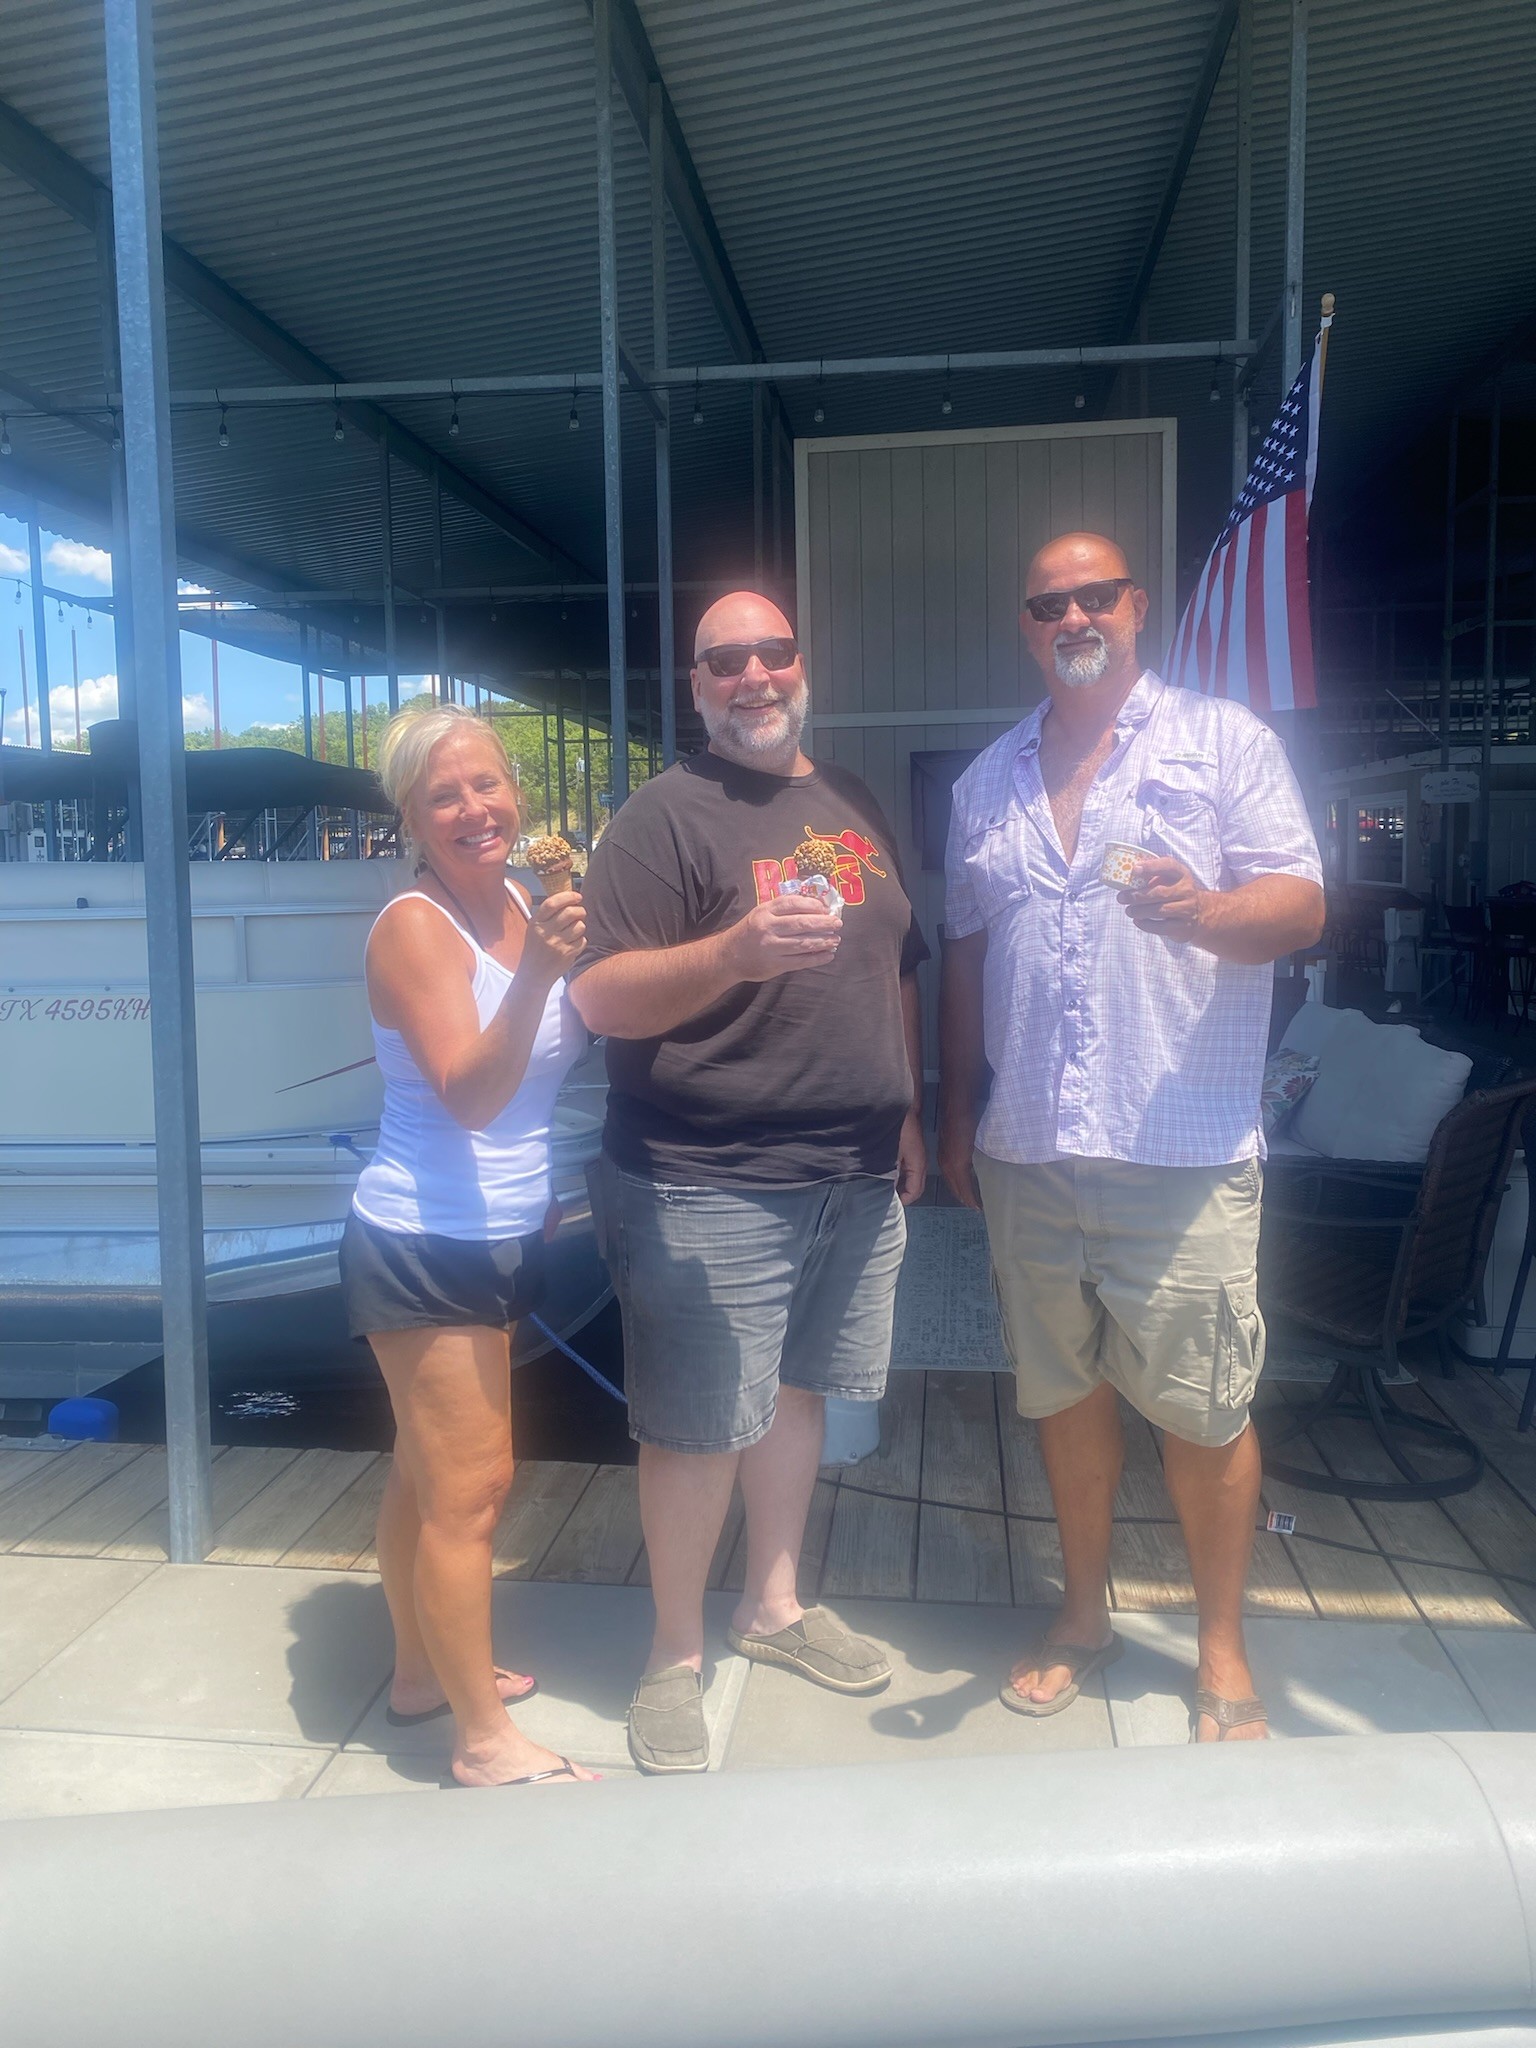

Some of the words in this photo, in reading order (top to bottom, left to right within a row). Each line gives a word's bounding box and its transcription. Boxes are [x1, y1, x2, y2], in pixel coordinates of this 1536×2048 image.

[752, 854, 866, 907] RS
[0, 998, 44, 1021] TX
[45, 998, 151, 1020] 4595KH
